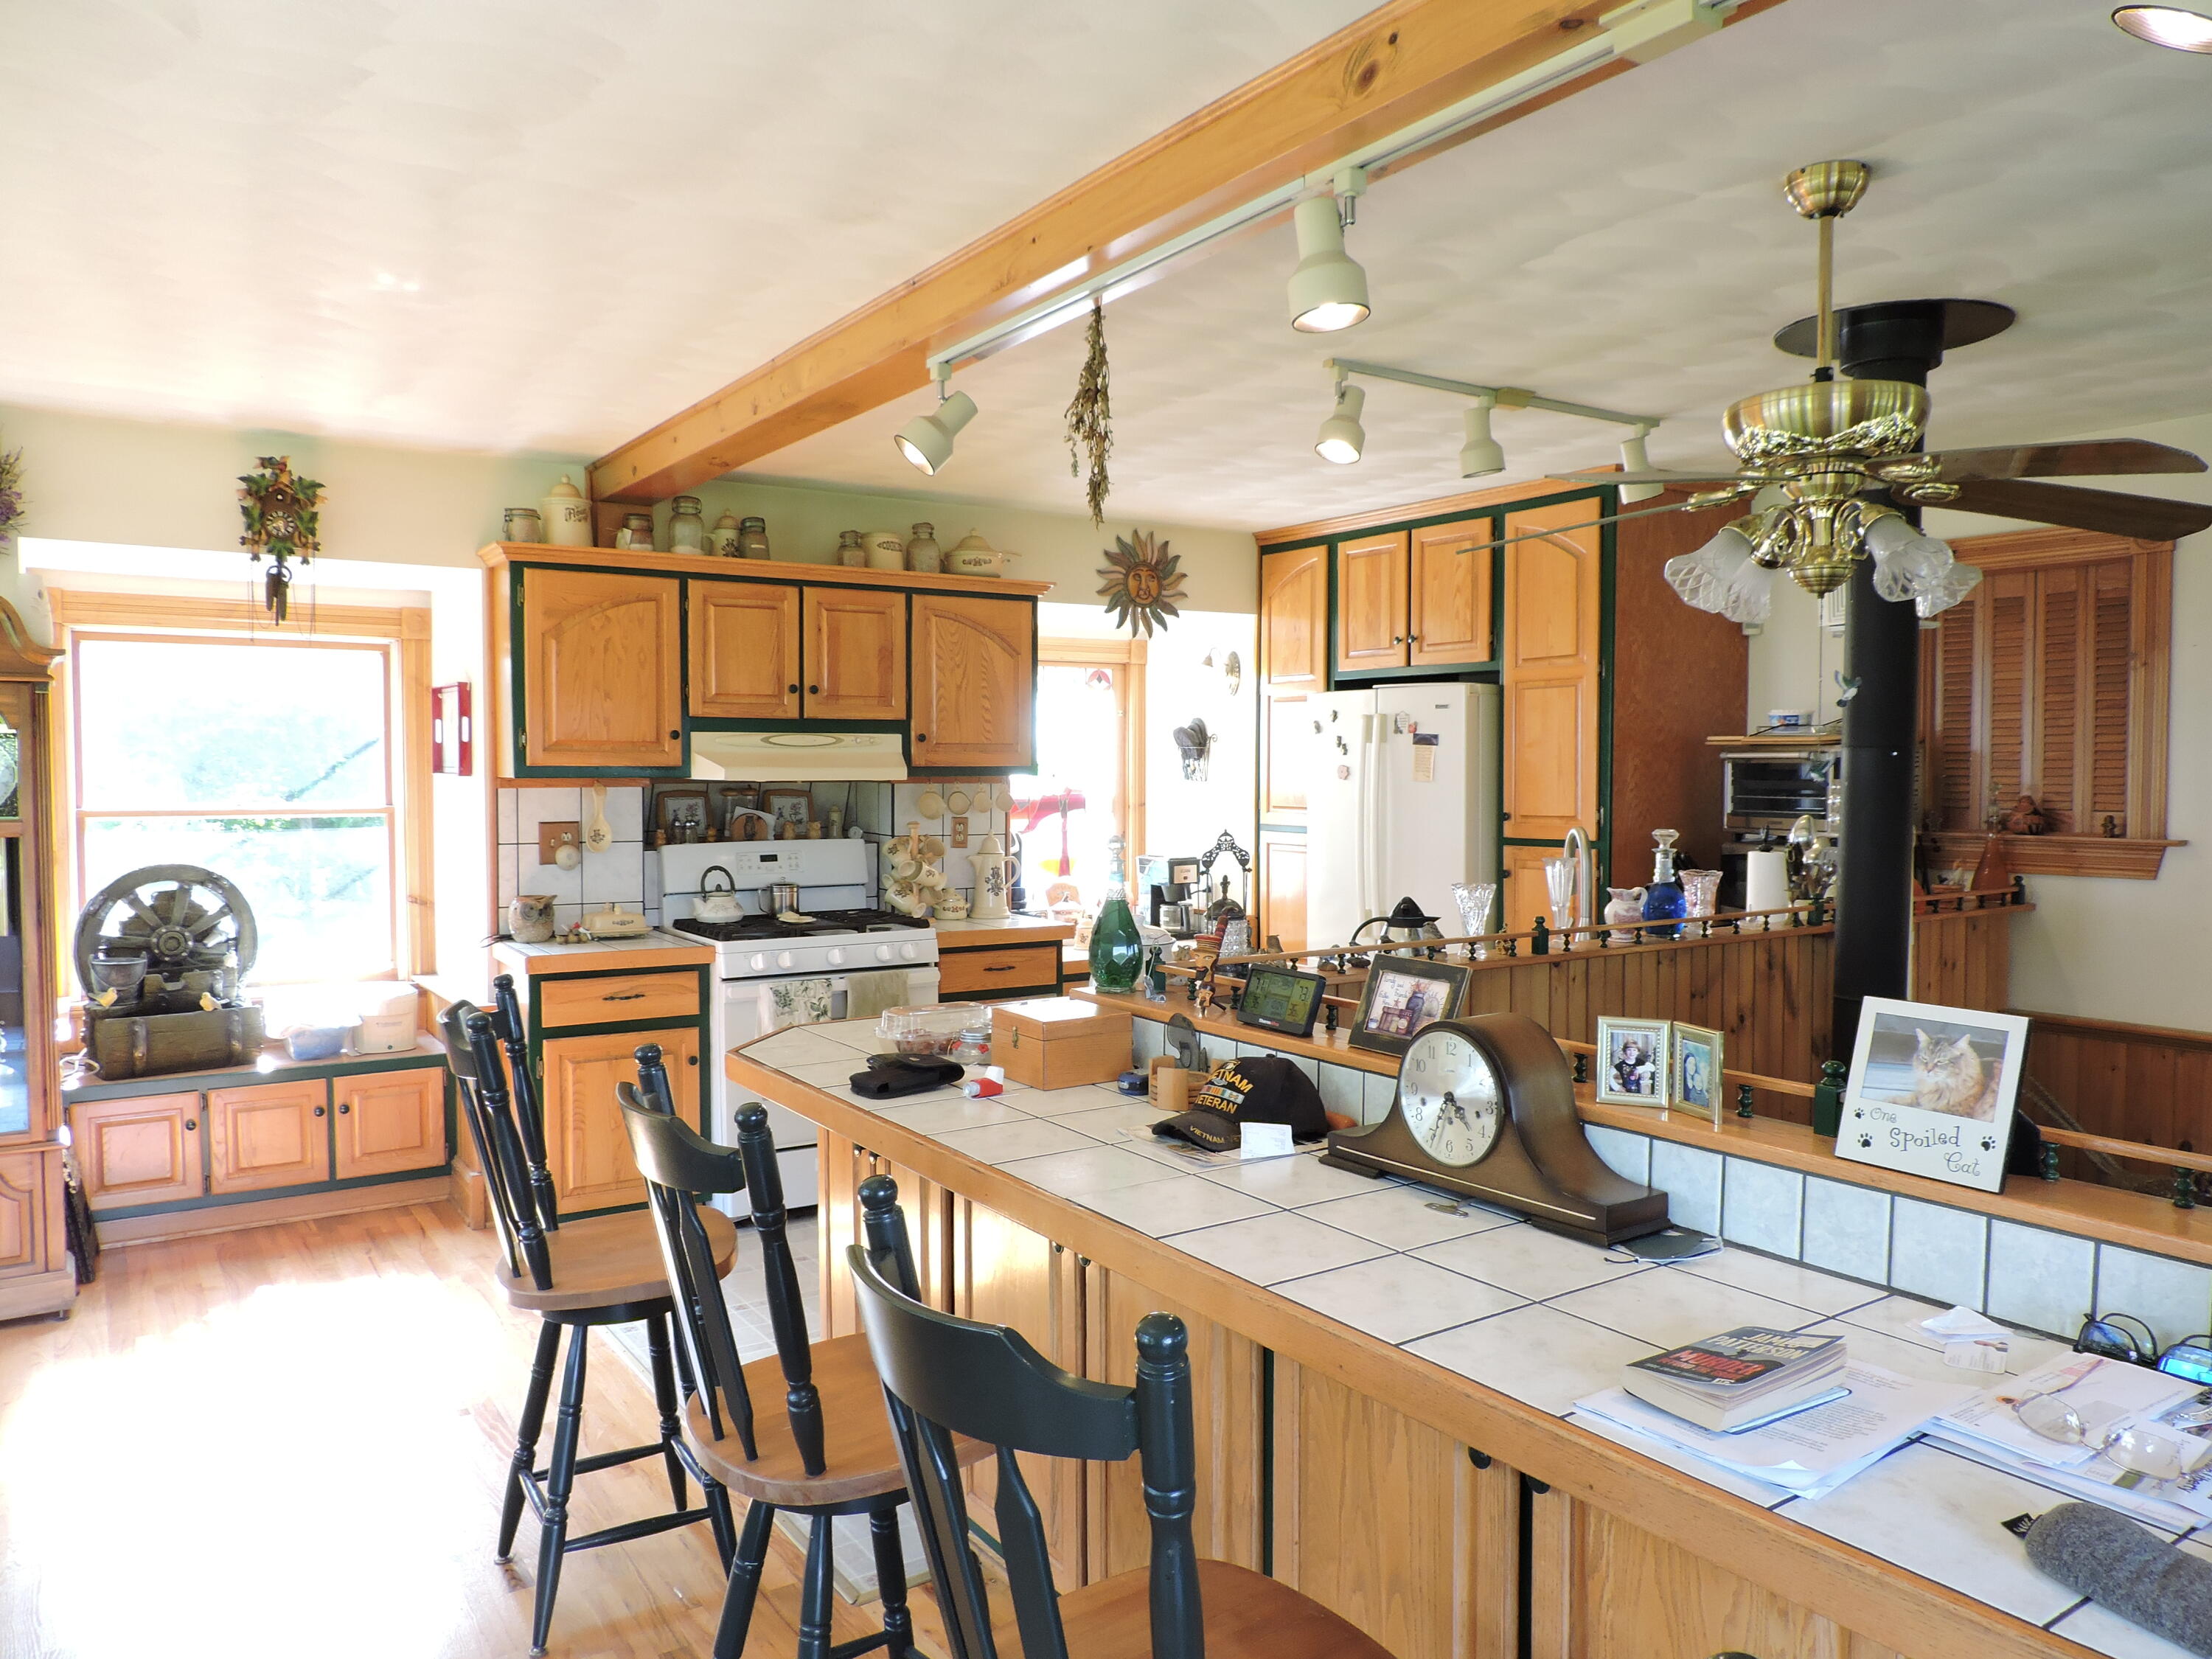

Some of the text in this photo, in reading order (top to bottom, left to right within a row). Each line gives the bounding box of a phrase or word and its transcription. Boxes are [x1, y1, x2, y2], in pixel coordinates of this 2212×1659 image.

[1427, 1045, 1436, 1060] 11
[1446, 1041, 1457, 1056] 12
[1416, 1059, 1426, 1073] 10
[1467, 1053, 1472, 1068] 1
[1208, 1069, 1253, 1093] ETNAM
[1411, 1082, 1418, 1096] 9
[1415, 1107, 1423, 1121] 8
[1485, 1101, 1494, 1115] 3
[1870, 1107, 1897, 1123] One
[1189, 1125, 1225, 1144] VIETNAM
[1478, 1124, 1486, 1138] 4
[1445, 1139, 1453, 1153] 6
[1465, 1138, 1474, 1152] 5
[1890, 1126, 1961, 1152] Spoiled
[1944, 1152, 1981, 1177] Cat
[1706, 1335, 1809, 1360] PATTERSON
[1669, 1349, 1766, 1375] MURDER
